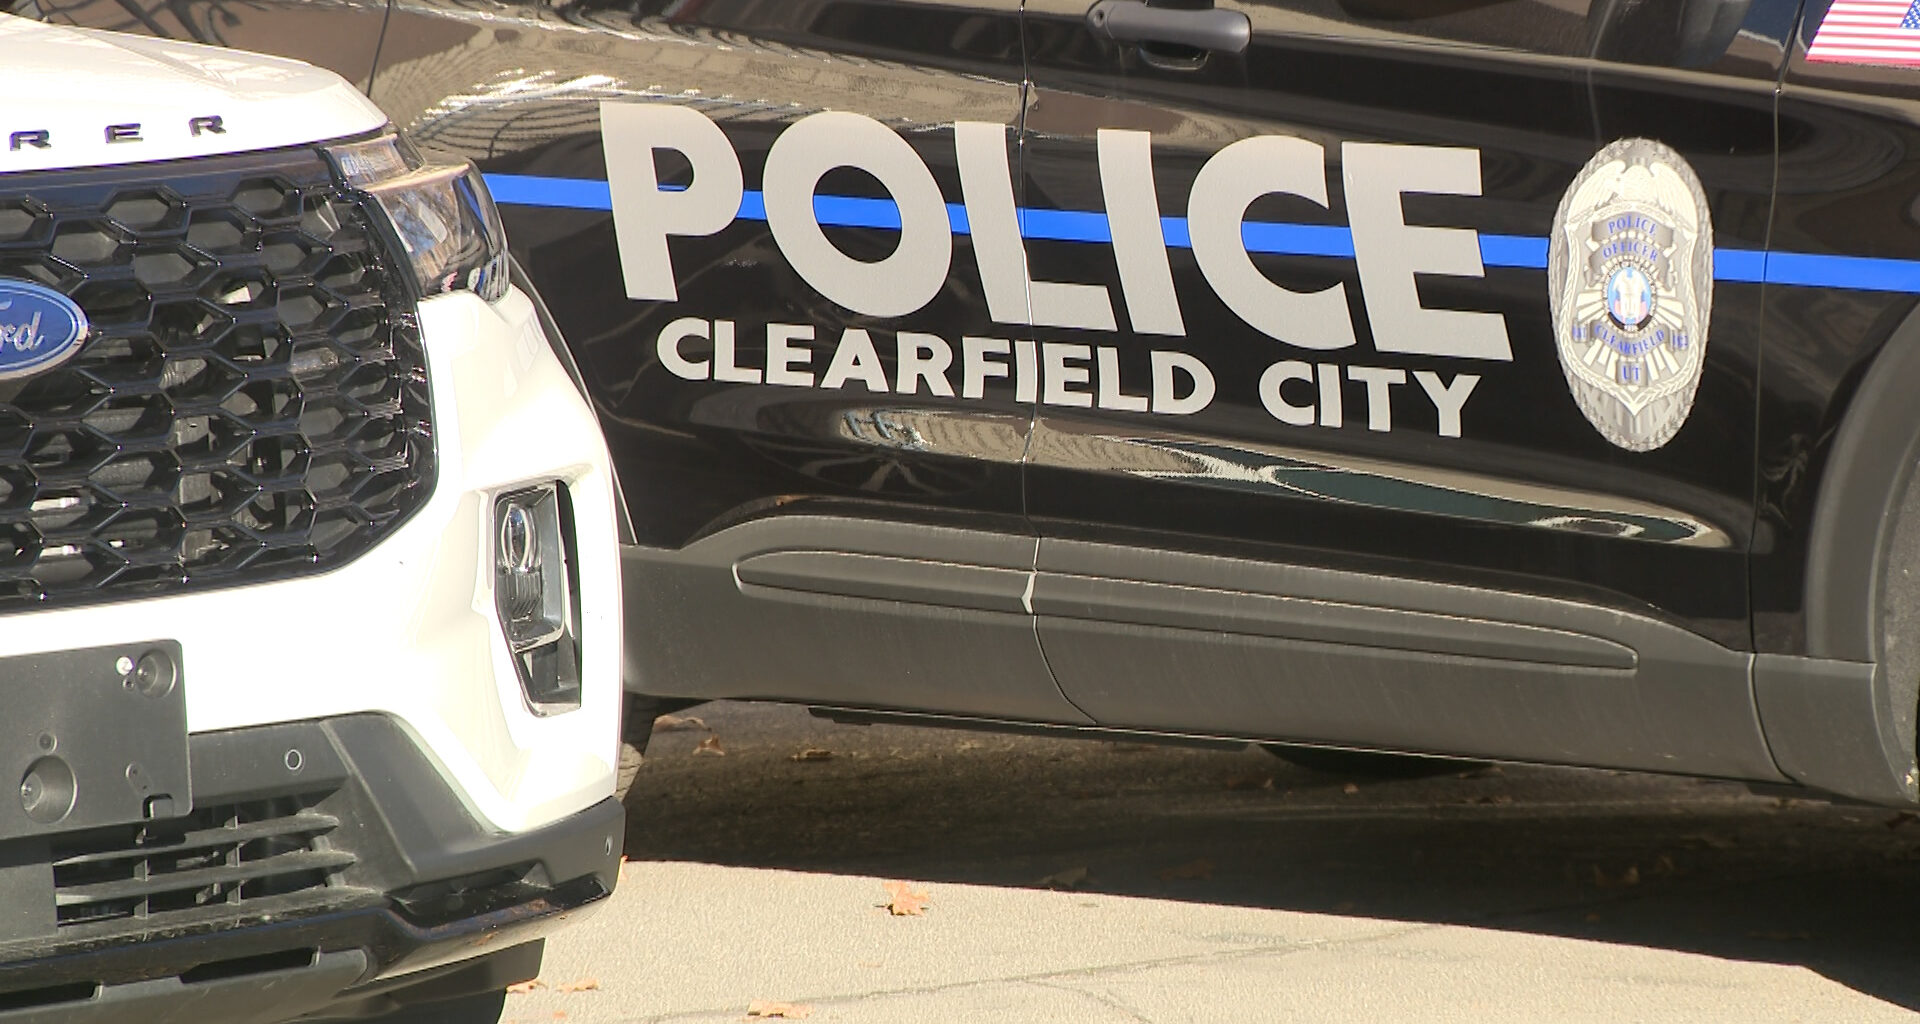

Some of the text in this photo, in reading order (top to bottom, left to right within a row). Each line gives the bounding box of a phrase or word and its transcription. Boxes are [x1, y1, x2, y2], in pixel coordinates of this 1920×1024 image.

[600, 101, 1514, 361] POLICE
[1608, 215, 1656, 234] POLICE
[1603, 240, 1658, 261] OFFICER
[1593, 324, 1665, 356] CLEARFIELD
[656, 317, 1482, 438] CLEARFIELD CITY
[1622, 365, 1641, 381] UT
